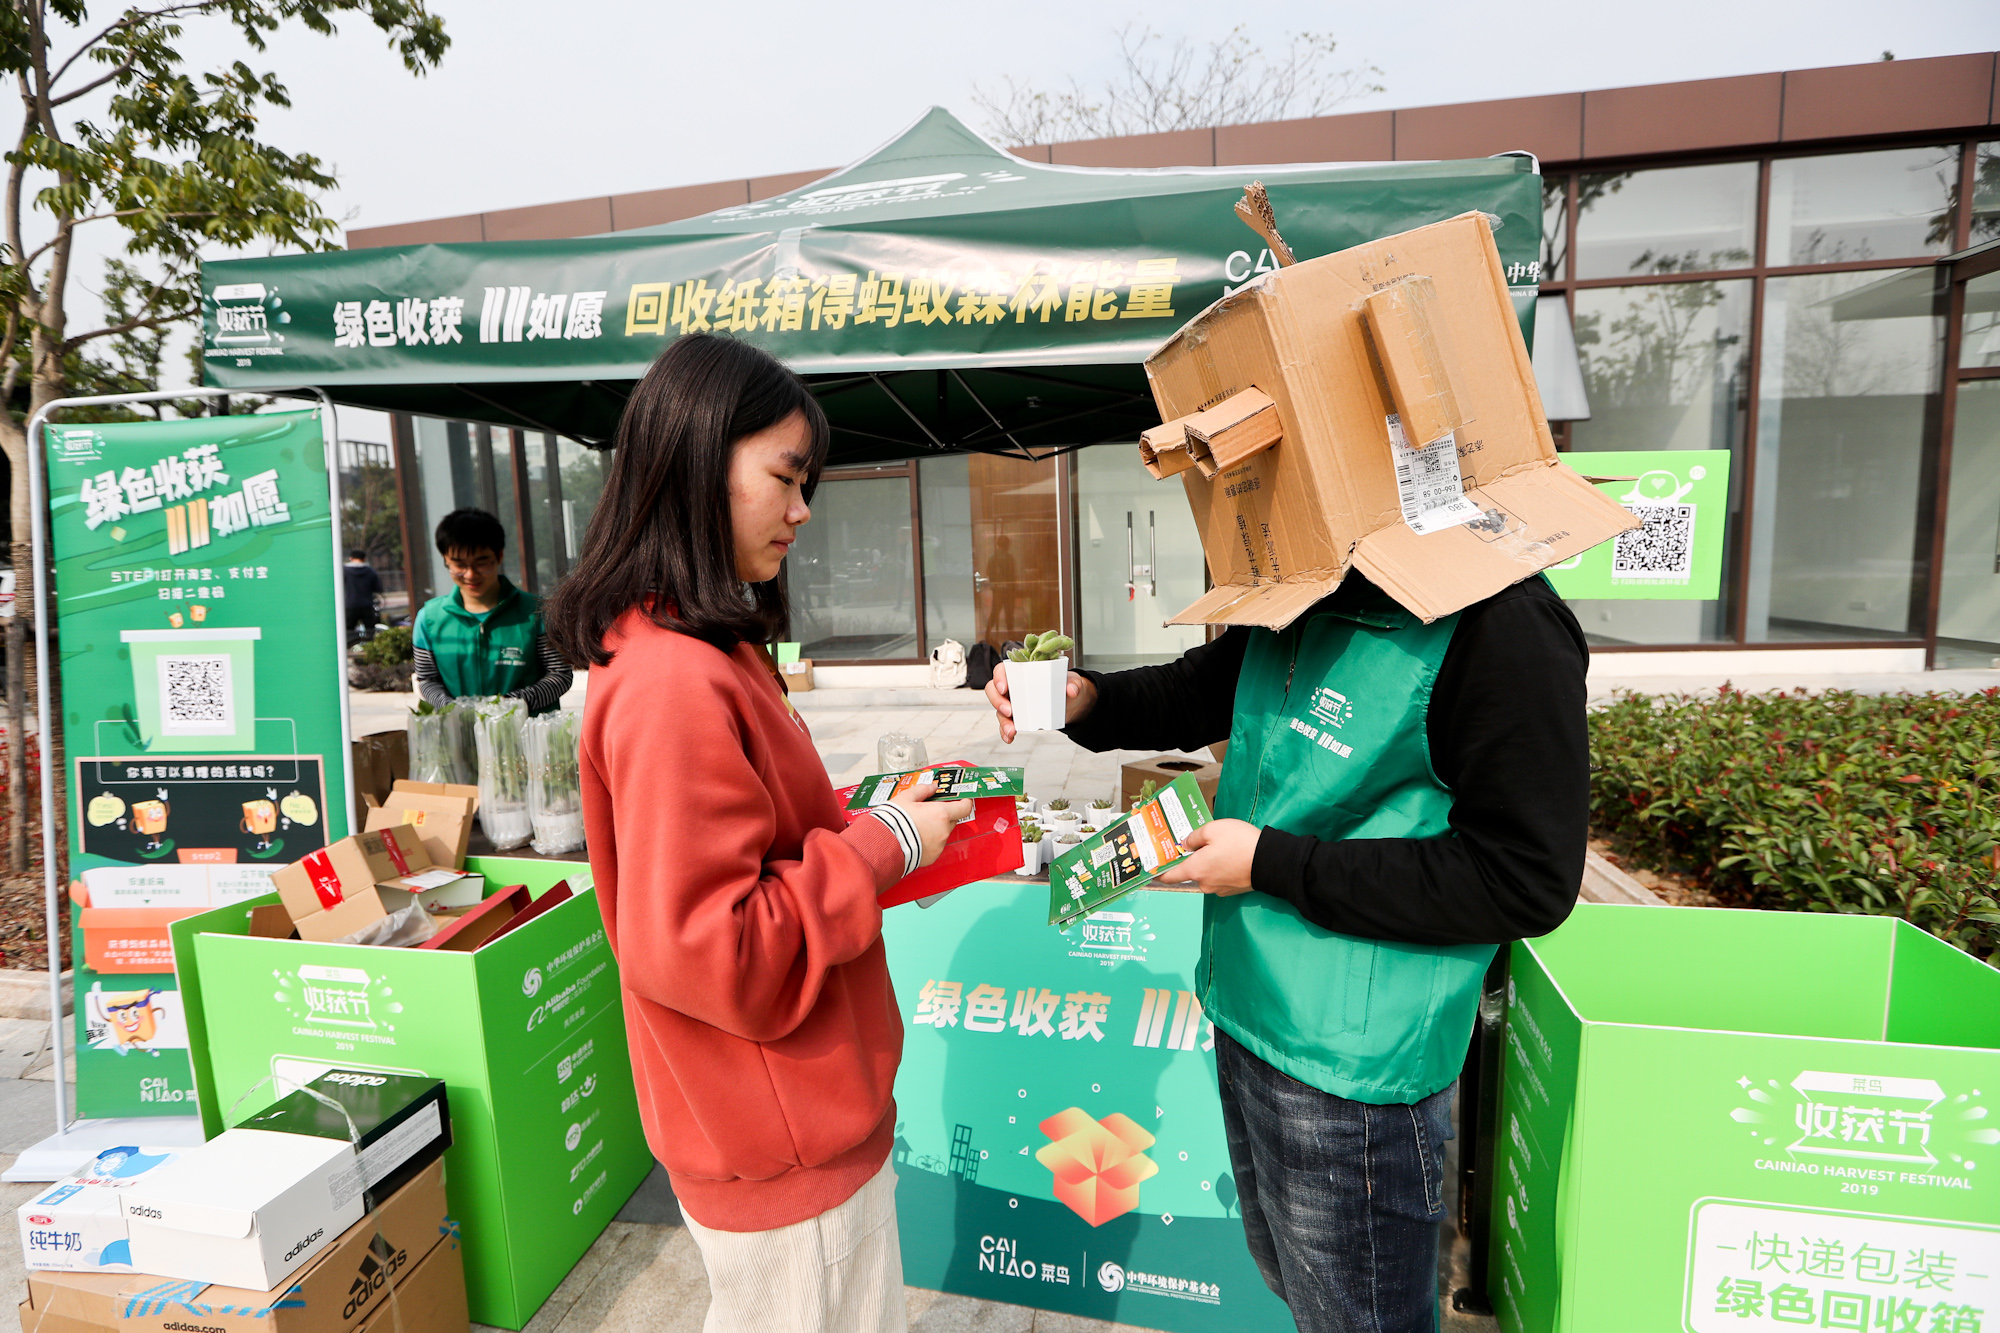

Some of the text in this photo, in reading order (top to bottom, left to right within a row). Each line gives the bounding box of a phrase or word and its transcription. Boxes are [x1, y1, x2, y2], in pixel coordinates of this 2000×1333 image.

[1225, 248, 1292, 283] CA
[333, 296, 464, 348] 绿色收获
[625, 257, 1182, 337] 回收纸箱得蚂蚁森林能量
[80, 443, 230, 531] 绿色收获
[158, 586, 225, 600] 扫描二维码
[1082, 924, 1132, 943] 收获节
[1068, 951, 1147, 962] CAINIAO HARVEST FESTIVAL
[545, 962, 607, 1011] Alibaba Foundation
[303, 986, 370, 1015] 收获节
[912, 979, 1112, 1043] 绿色收获
[292, 1027, 397, 1045] CAINIAO HARVEST FESTIVAL
[335, 1042, 355, 1051] 2019
[323, 1072, 388, 1087] adidas
[1852, 1077, 1883, 1093] 菜鸟
[1794, 1102, 1934, 1146] 收获节
[1754, 1158, 1972, 1190] CAINIAO HARVEST FESTIVAL
[1840, 1182, 1879, 1196] 2019
[130, 1205, 163, 1220] adidas
[29, 1230, 83, 1252] 纯牛奶
[284, 1227, 324, 1263] adidas
[980, 1235, 1017, 1258] CAI
[343, 1249, 408, 1320] adidas
[979, 1252, 1221, 1298] NIAO 菜鸟 中华环境保护基金会
[1714, 1276, 1985, 1333] 绿色回收箱
[163, 1322, 226, 1333] adidas.com
